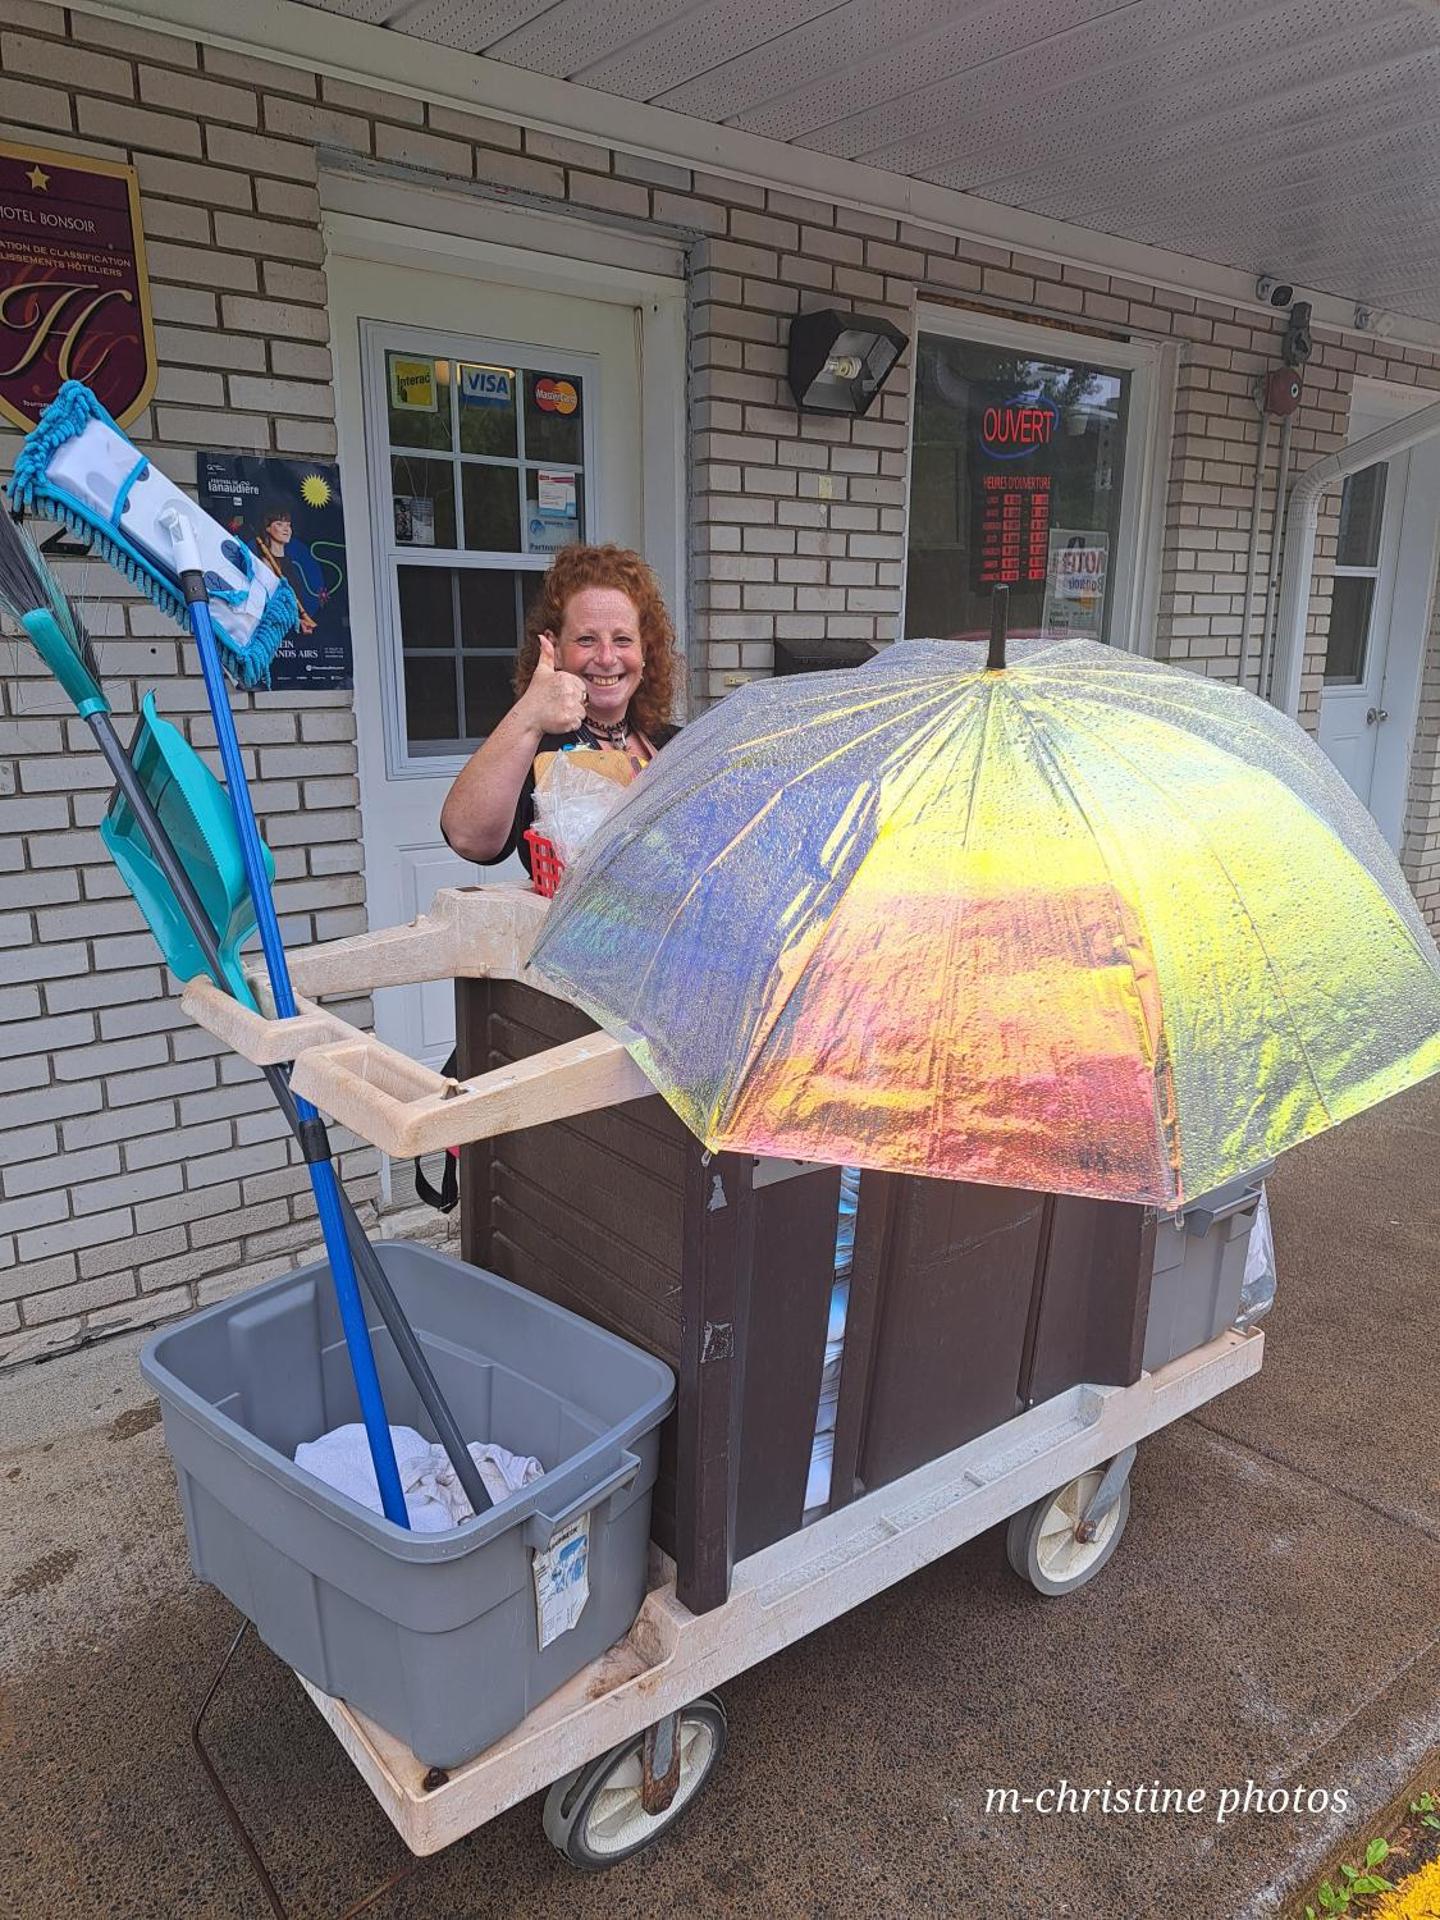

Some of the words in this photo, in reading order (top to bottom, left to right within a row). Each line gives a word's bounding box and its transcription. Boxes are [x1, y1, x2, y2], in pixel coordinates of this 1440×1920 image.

[40, 212, 97, 233] BONSOIR
[33, 246, 47, 254] DE
[50, 248, 131, 267] CLASSIFICATION
[67, 261, 122, 277] HÔTELIERS
[397, 373, 431, 388] Interac
[468, 373, 508, 395] VISA
[535, 389, 577, 404] MasterCard
[983, 407, 1055, 444] OUVERT
[299, 650, 318, 659] AIRS
